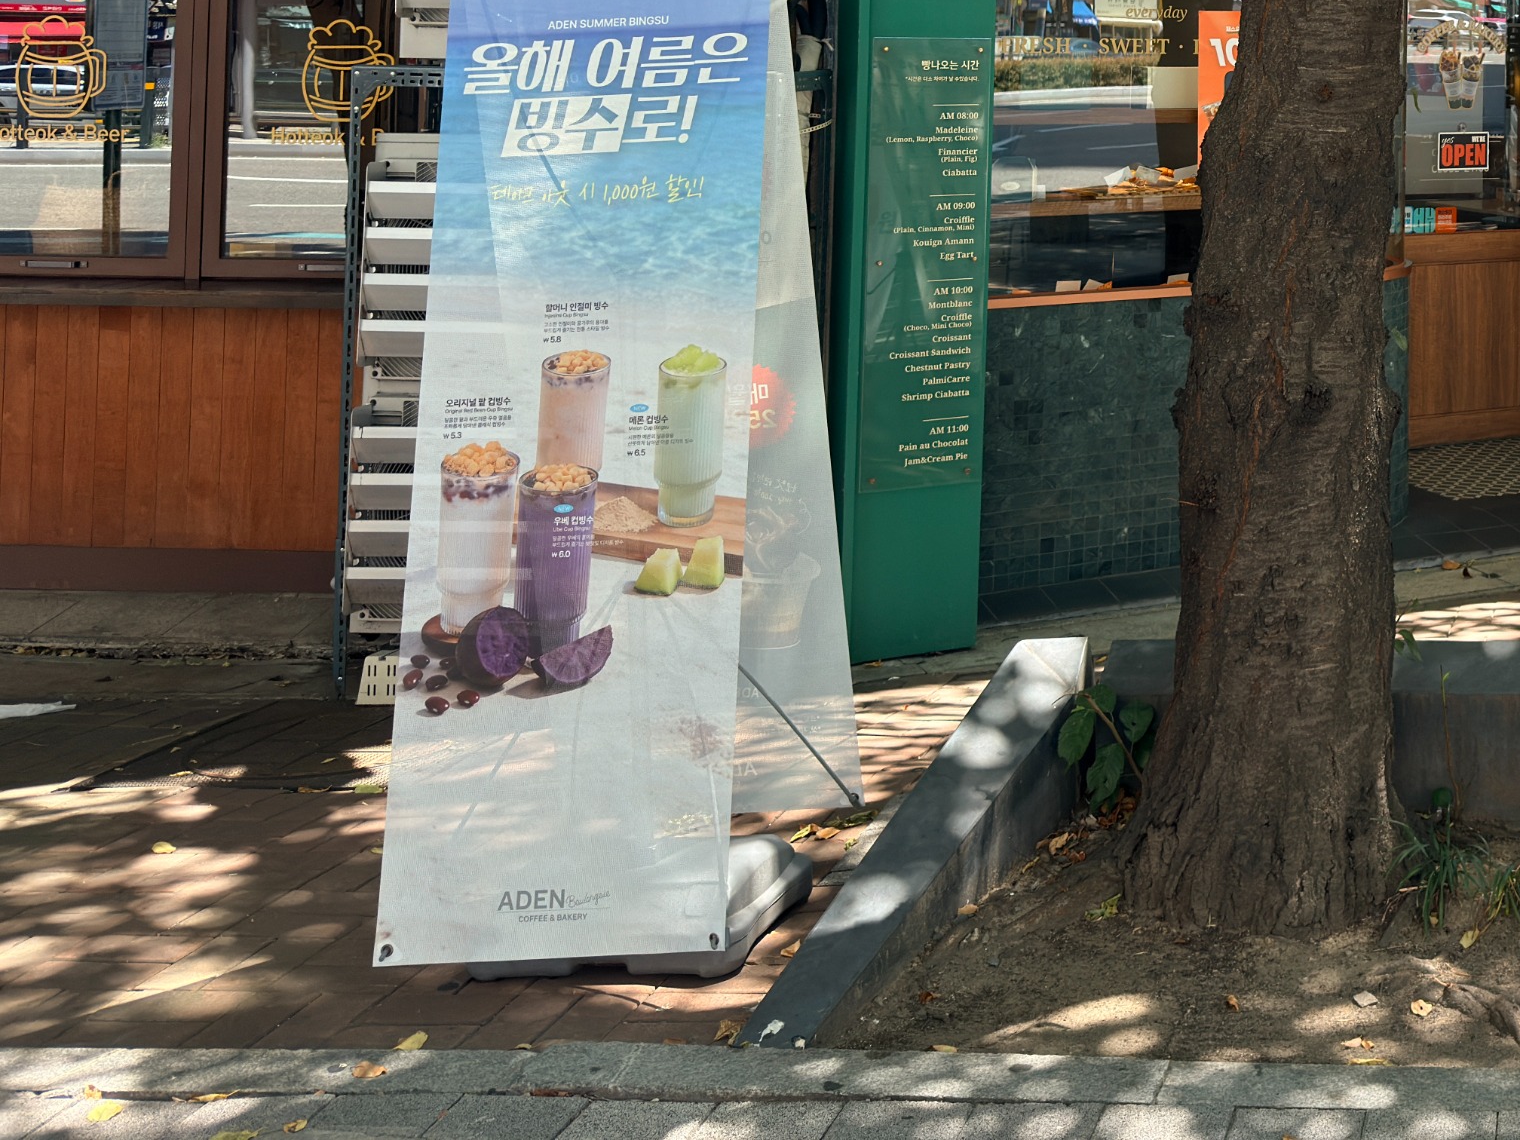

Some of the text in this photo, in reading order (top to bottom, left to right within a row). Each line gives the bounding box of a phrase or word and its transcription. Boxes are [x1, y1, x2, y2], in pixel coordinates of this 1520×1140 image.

[1125, 6, 1188, 22] everyday
[548, 15, 669, 30] ADEN SUMMER BINGSU
[1001, 37, 1170, 55] FRESH SWEET
[463, 32, 748, 95] 올해 여름은
[921, 60, 979, 71] 빵나오는 시간
[940, 112, 979, 120] AM 08:00
[513, 95, 699, 154] 빙수로!
[935, 126, 979, 134] Madeleine
[64, 124, 78, 142] &
[84, 125, 130, 142] Beer
[271, 127, 346, 146] Hotteok
[1441, 136, 1455, 149] yes
[938, 148, 978, 156] Financier
[1441, 143, 1486, 167] OPEN
[964, 155, 978, 163] Fig)
[603, 175, 660, 206] 1,000원
[936, 202, 976, 211] AM 09:00
[944, 216, 975, 224] Croiffle
[913, 239, 943, 247] Kouign
[940, 251, 974, 261] Egg Tart
[933, 286, 973, 296] AM 10:00
[546, 301, 609, 313] 할머니 인절미 빙수
[928, 300, 973, 309] Montblanc
[941, 313, 972, 322] Croiffle
[903, 324, 930, 332] (Choco,
[948, 321, 972, 329] Choco)
[932, 333, 971, 343] Croissant
[889, 347, 971, 360] Croissant Sandwich
[904, 361, 971, 373] Chestnut Pastry
[901, 389, 970, 402] Shrimp Ciabatta
[445, 398, 476, 407] 오리지널
[488, 396, 511, 406] 컵빙수
[646, 415, 669, 425] 컵빙수
[929, 424, 969, 436] AM 11:00
[898, 443, 918, 452] Pain
[932, 438, 968, 448] Chocolat
[904, 452, 968, 468] Jam&Cream Pie
[571, 515, 593, 525] 컵빙수
[497, 889, 565, 911] ADEN
[518, 913, 588, 923] COFFEE & BAKERY
